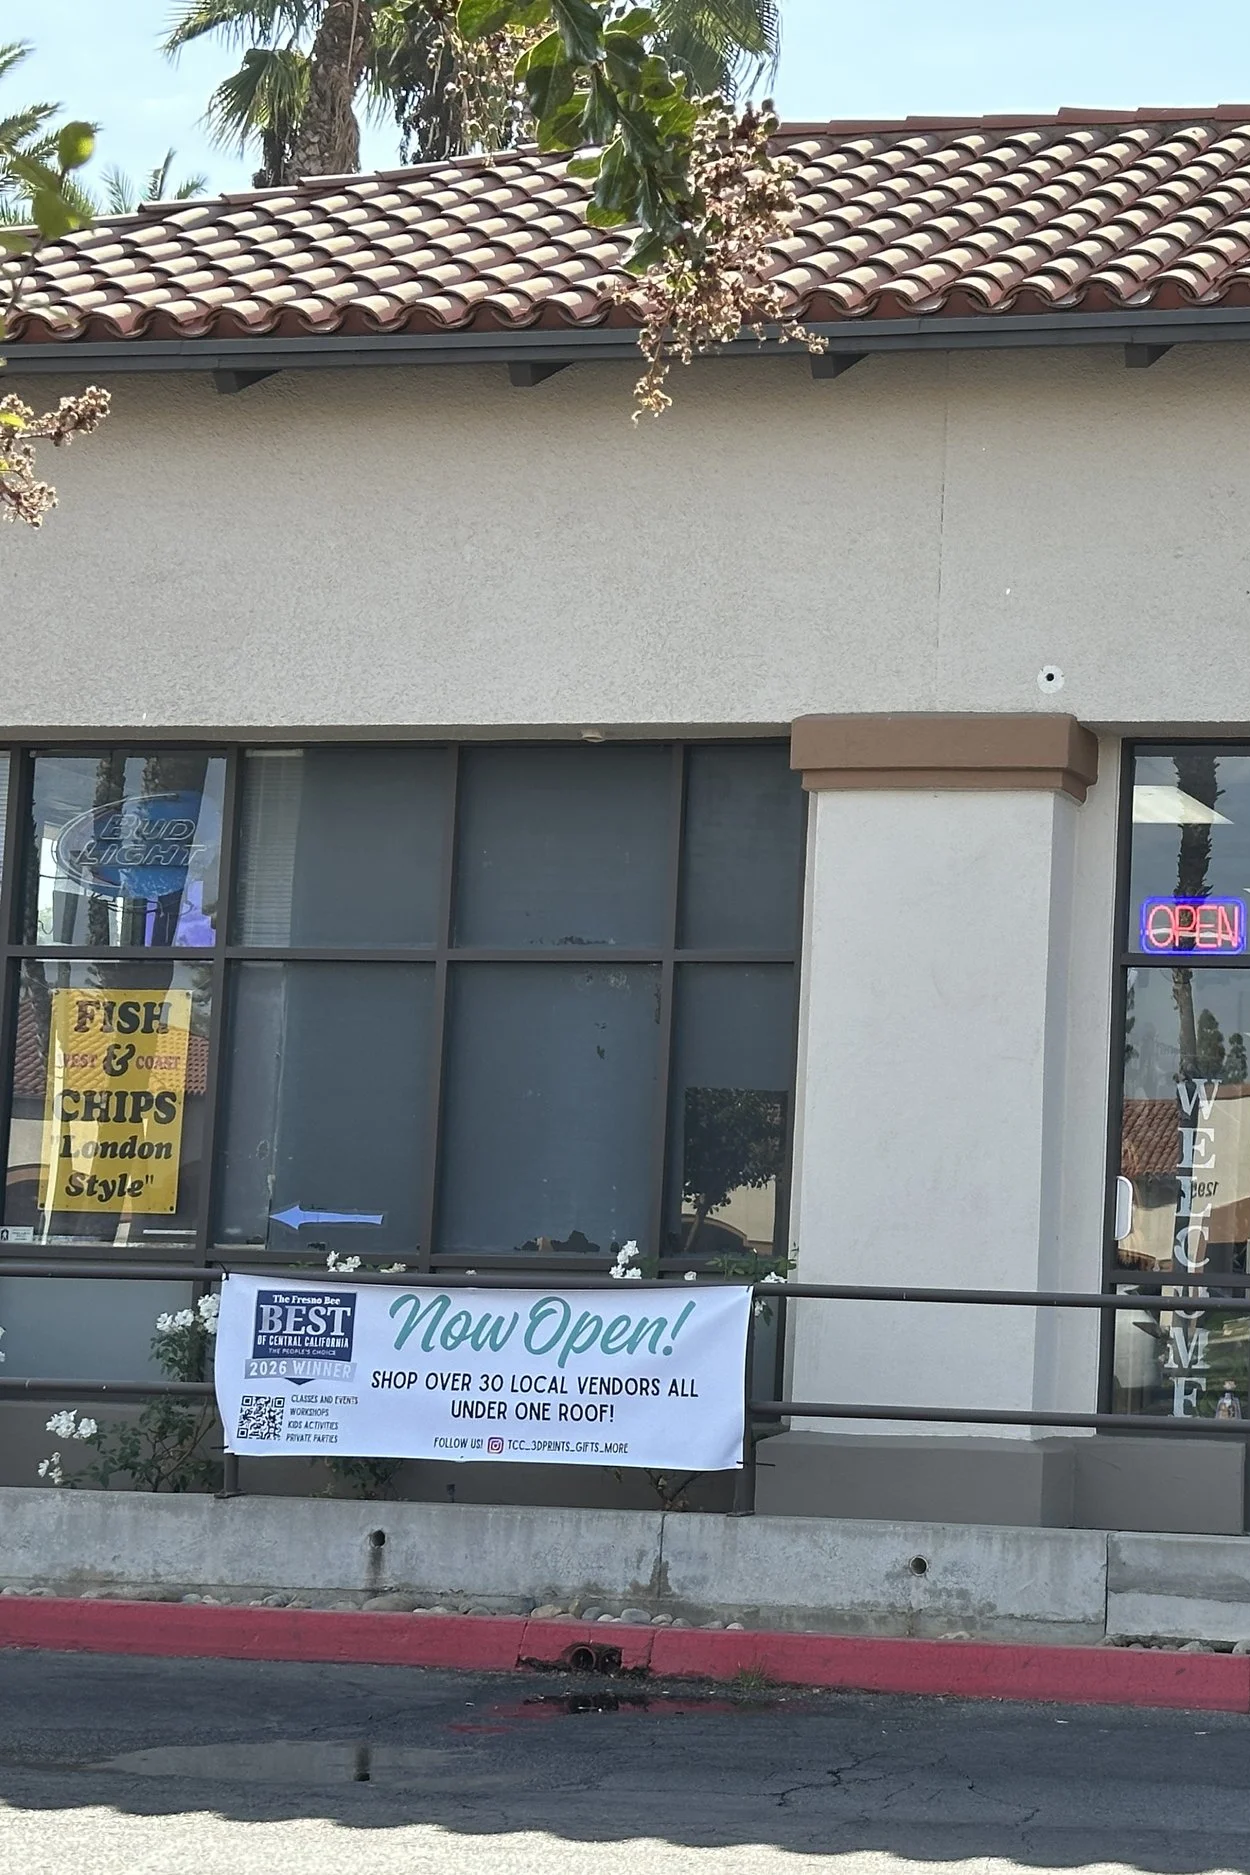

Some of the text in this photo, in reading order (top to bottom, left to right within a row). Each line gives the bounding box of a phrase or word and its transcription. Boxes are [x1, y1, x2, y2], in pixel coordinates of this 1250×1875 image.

[101, 813, 196, 841] BUD
[75, 839, 207, 867] LIGHT
[1147, 904, 1239, 948] OPEN
[74, 1000, 172, 1034] FISH
[103, 1044, 136, 1077] &
[136, 1056, 180, 1070] COAST
[56, 1089, 176, 1124] CHIPS
[65, 1172, 153, 1202] Style"
[272, 1294, 341, 1305] The Fresno Bee
[258, 1304, 352, 1336] BEST
[389, 1293, 697, 1369] Now Open!
[257, 1335, 349, 1348] OF CENTRAL CALIFORNIA
[249, 1360, 352, 1379] 2026 WINNER
[371, 1370, 699, 1398] SHOP OVER 30 LOCAL VENDORS ALL
[290, 1408, 330, 1417] WORKSHOPS
[291, 1394, 359, 1405] CLASSES AND EVENTS
[451, 1399, 615, 1423] UNDER ONE ROOF!
[286, 1433, 338, 1443] PRIVATE PARTIES
[287, 1421, 339, 1430] KIDS ACTIVITIES
[433, 1436, 468, 1449] FOLLOW
[470, 1437, 484, 1449] US!
